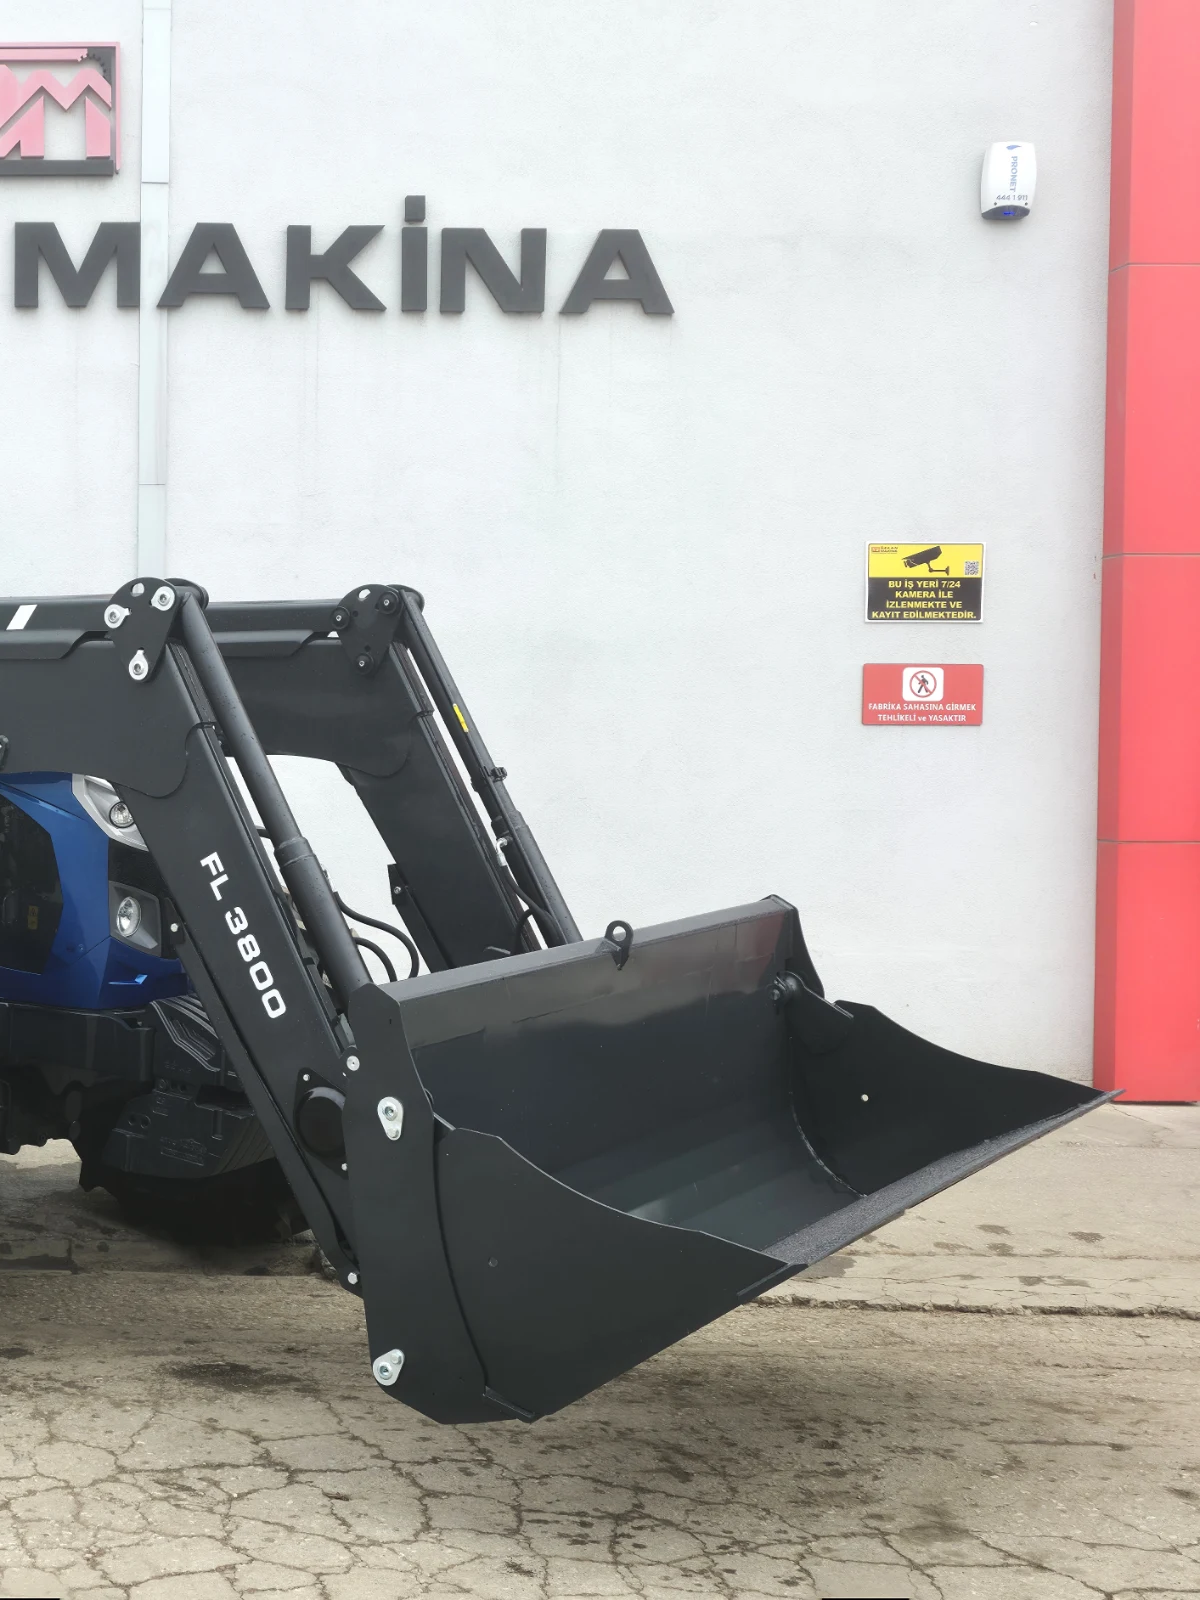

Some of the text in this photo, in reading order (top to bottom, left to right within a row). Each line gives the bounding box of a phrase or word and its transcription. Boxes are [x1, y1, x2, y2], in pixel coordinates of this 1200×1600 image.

[1010, 156, 1018, 192] PRONET
[14, 195, 675, 314] MAKİNA
[888, 579, 961, 589] BU İŞ YERİ 7/24
[895, 589, 953, 598] KAMERA İLE
[886, 600, 947, 608] İZLENMEKTE
[871, 609, 977, 619] KAYIT EDİLMEKTEDİR.
[868, 702, 977, 711] FABRİKA SAHASINA GİRMEK
[877, 713, 916, 722] TEHLİKELİ
[928, 714, 967, 722] YASAKTIR
[200, 851, 286, 1019] FL 3800
